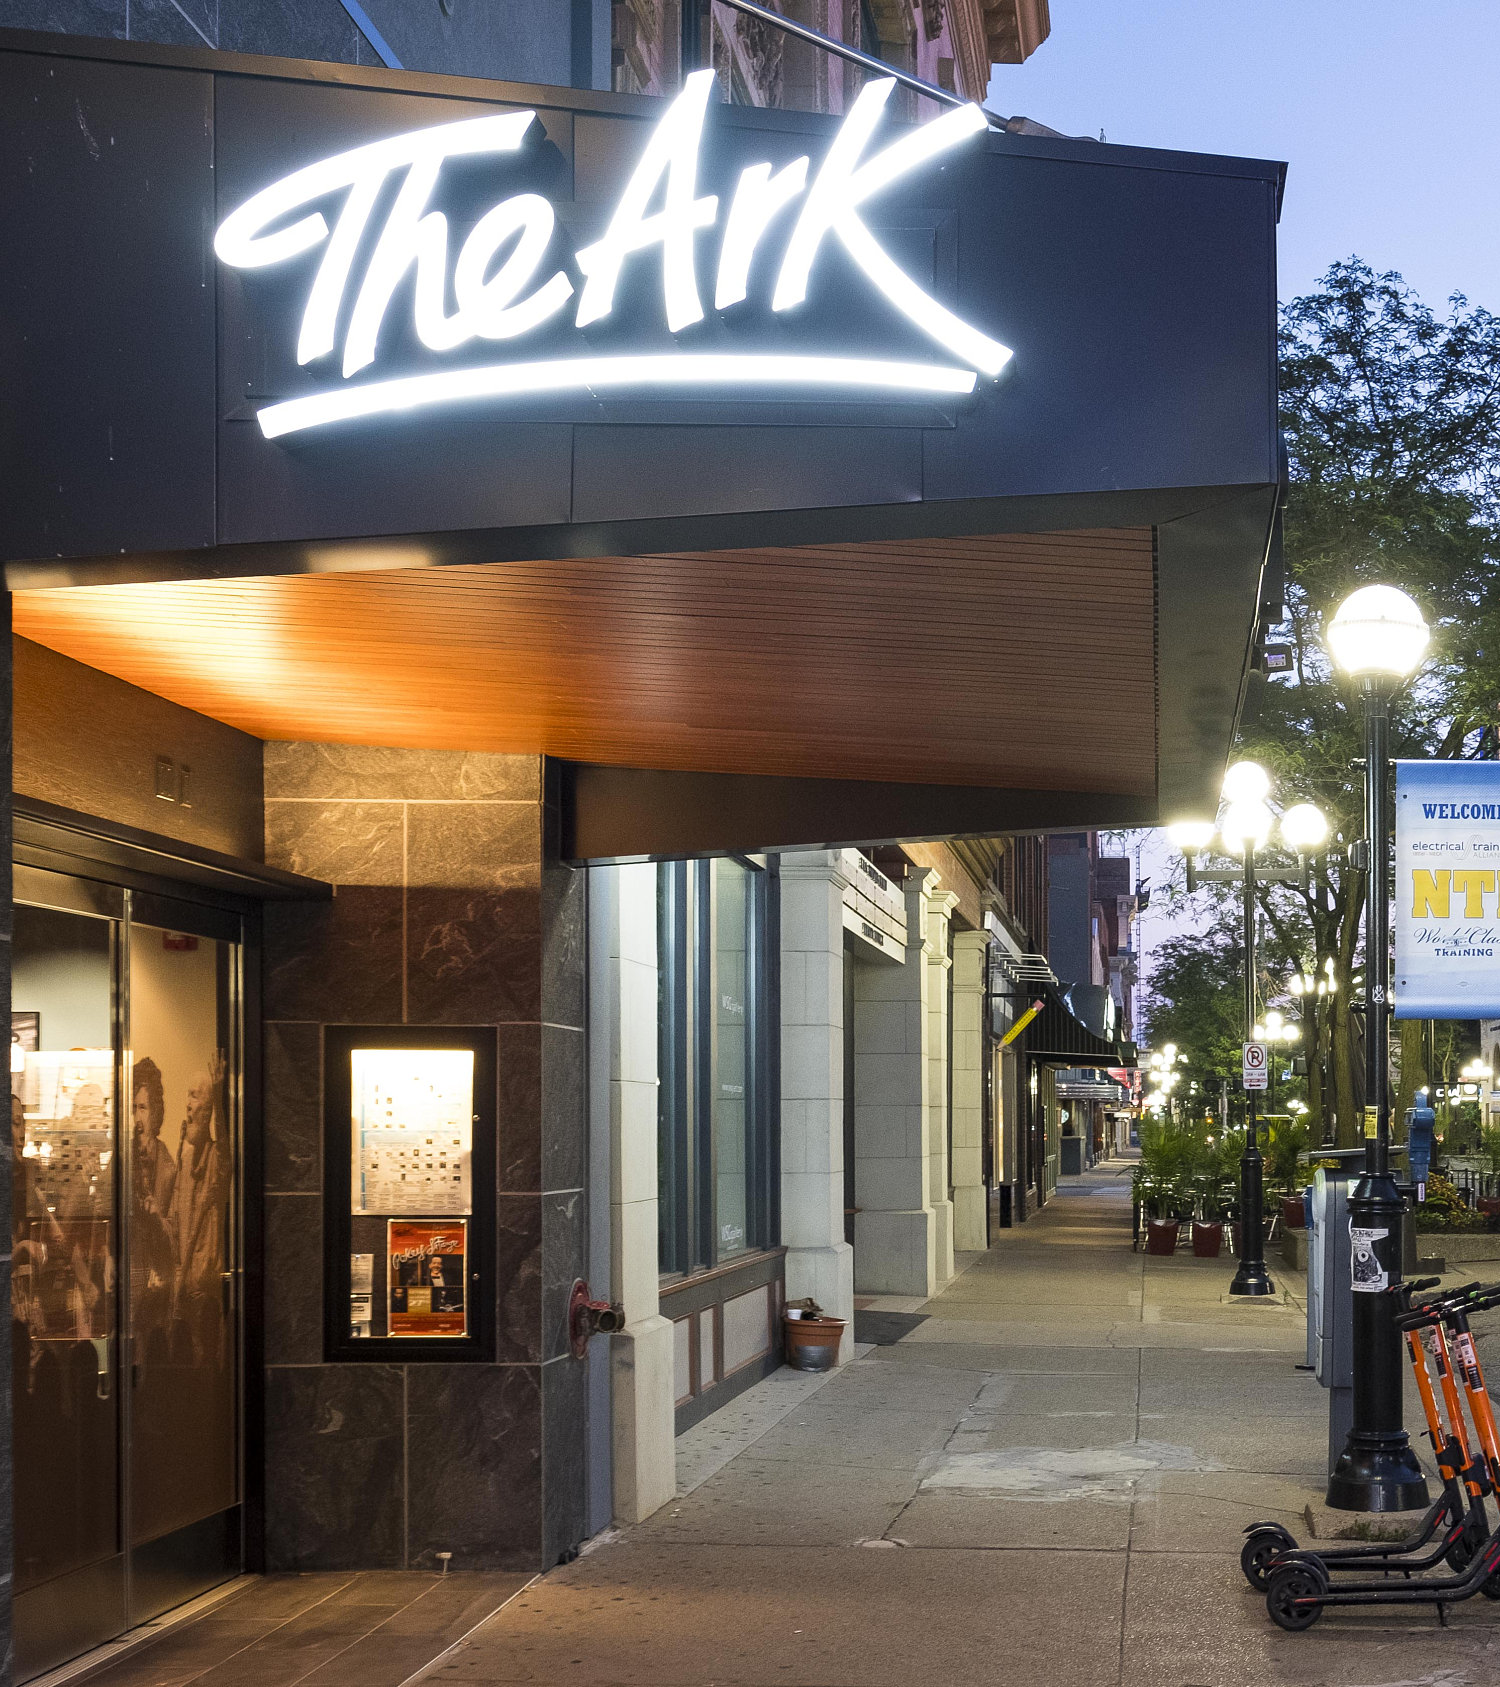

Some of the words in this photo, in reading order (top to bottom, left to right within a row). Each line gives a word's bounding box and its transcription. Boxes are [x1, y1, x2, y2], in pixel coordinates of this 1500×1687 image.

[214, 110, 575, 379] The
[1412, 841, 1464, 851] electrical
[1434, 948, 1493, 957] TRAINING
